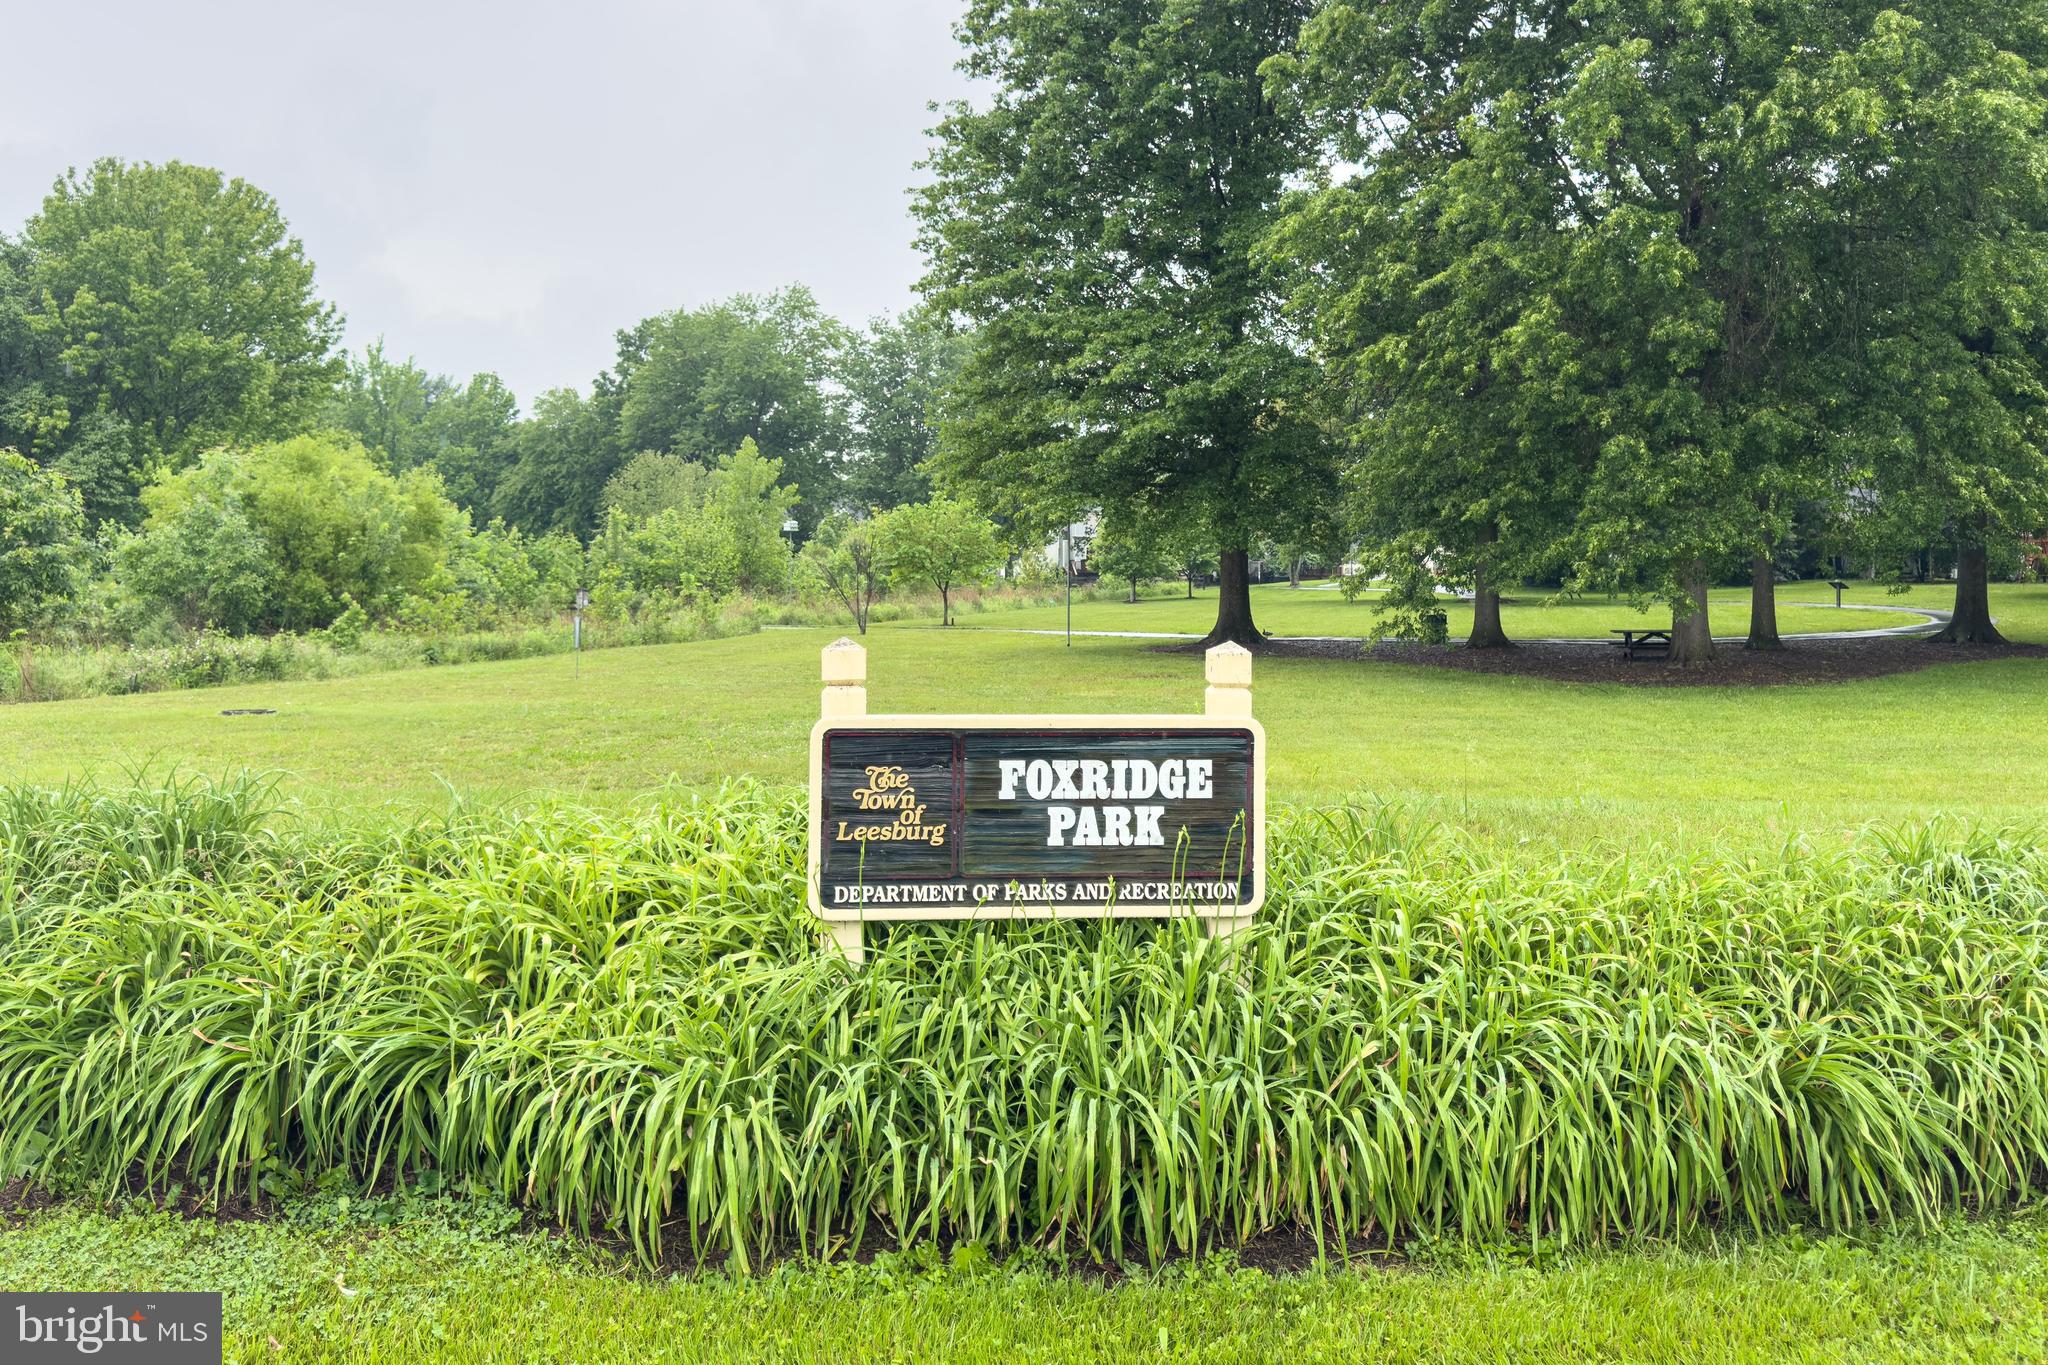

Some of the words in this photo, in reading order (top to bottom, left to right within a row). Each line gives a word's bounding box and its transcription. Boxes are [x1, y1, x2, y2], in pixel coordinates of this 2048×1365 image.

[865, 766, 909, 792] The
[998, 759, 1213, 799] FOXRIDGE
[852, 787, 915, 809] Town
[900, 804, 927, 825] of
[1046, 806, 1165, 846] PARK
[836, 821, 947, 846] Leesburg
[834, 885, 967, 903] DEPARTMENT
[972, 884, 999, 901] OF
[1004, 883, 1067, 900] PARKS
[1072, 883, 1113, 900] AND
[1119, 882, 1240, 899] RECREATION
